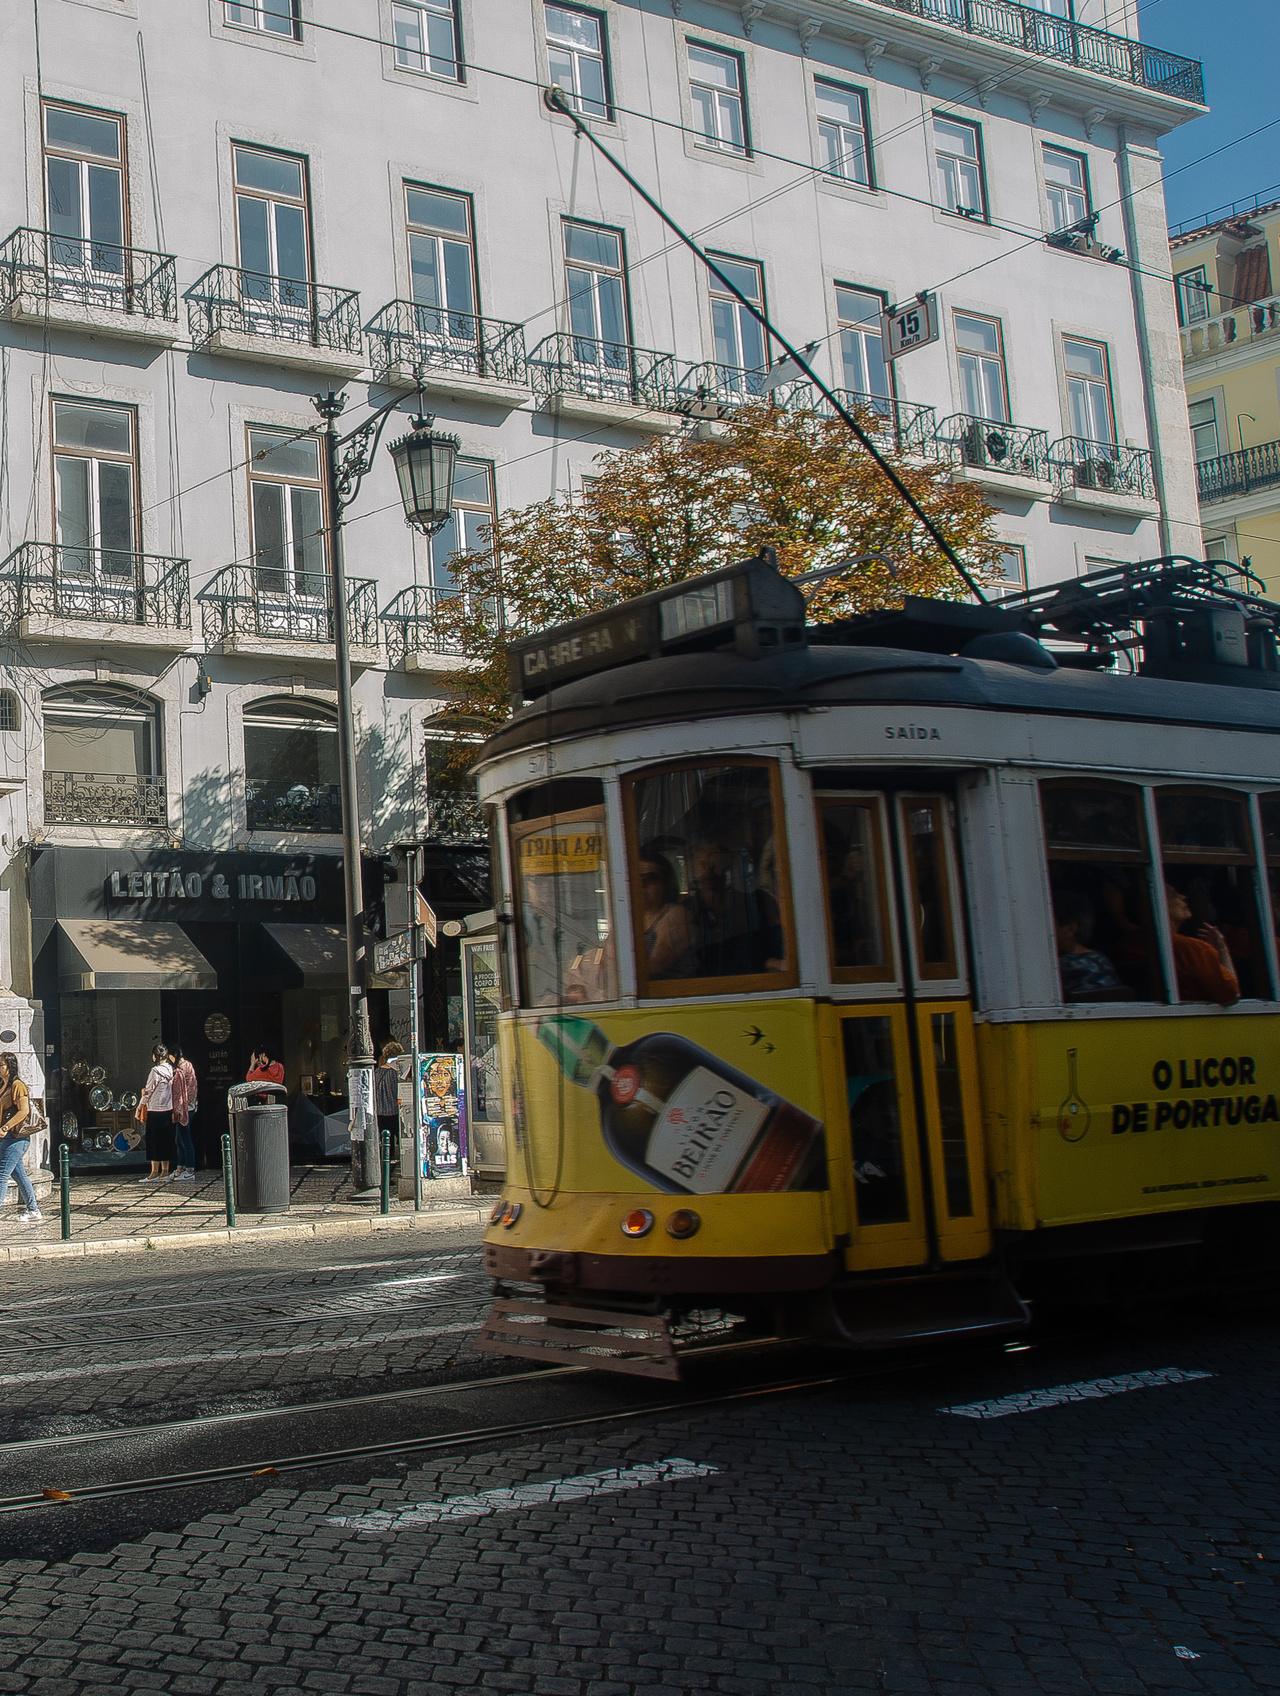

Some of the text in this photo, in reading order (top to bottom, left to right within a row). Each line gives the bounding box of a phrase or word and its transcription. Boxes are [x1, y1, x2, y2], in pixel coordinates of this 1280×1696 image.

[896, 310, 920, 338] 15
[884, 723, 941, 740] SAÍDA
[111, 866, 316, 900] LEITÃO & IRMÃO
[1153, 1056, 1256, 1091] O LICOR
[1112, 1094, 1280, 1135] DE PORTUGA
[672, 1090, 737, 1178] BEIRÃO
[435, 1155, 458, 1165] ELIS
